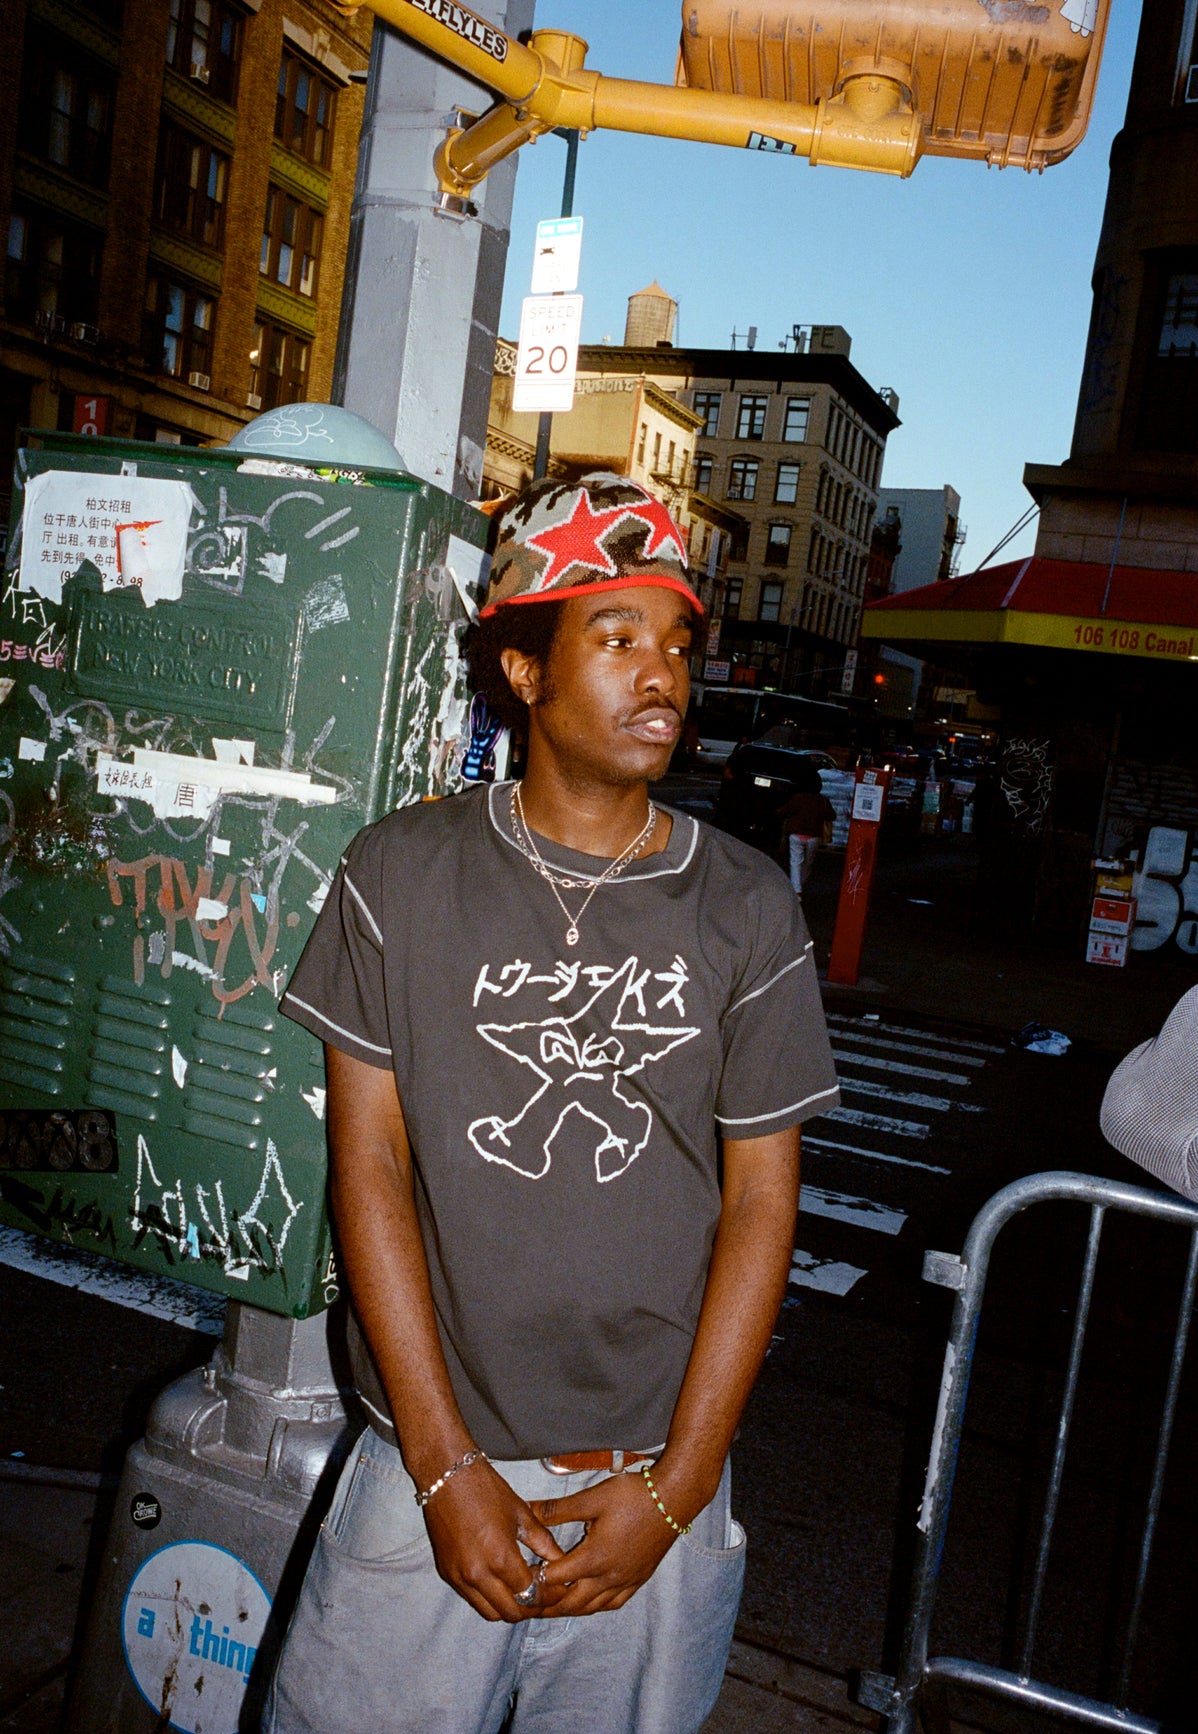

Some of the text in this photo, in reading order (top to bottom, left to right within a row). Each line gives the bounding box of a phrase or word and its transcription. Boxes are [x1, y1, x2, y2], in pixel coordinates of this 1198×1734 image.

[530, 306, 575, 319] SPEED
[531, 324, 567, 337] LIMIT
[525, 346, 568, 374] 20
[86, 497, 132, 514] 柏文招租
[86, 608, 277, 657] TRAFFIC CONTROL
[1074, 624, 1195, 656] 106 108 Canal
[94, 642, 142, 673] NEW
[147, 654, 201, 687] YORK
[209, 662, 263, 693] CITY
[174, 782, 199, 809] 唐
[137, 1607, 156, 1639] a
